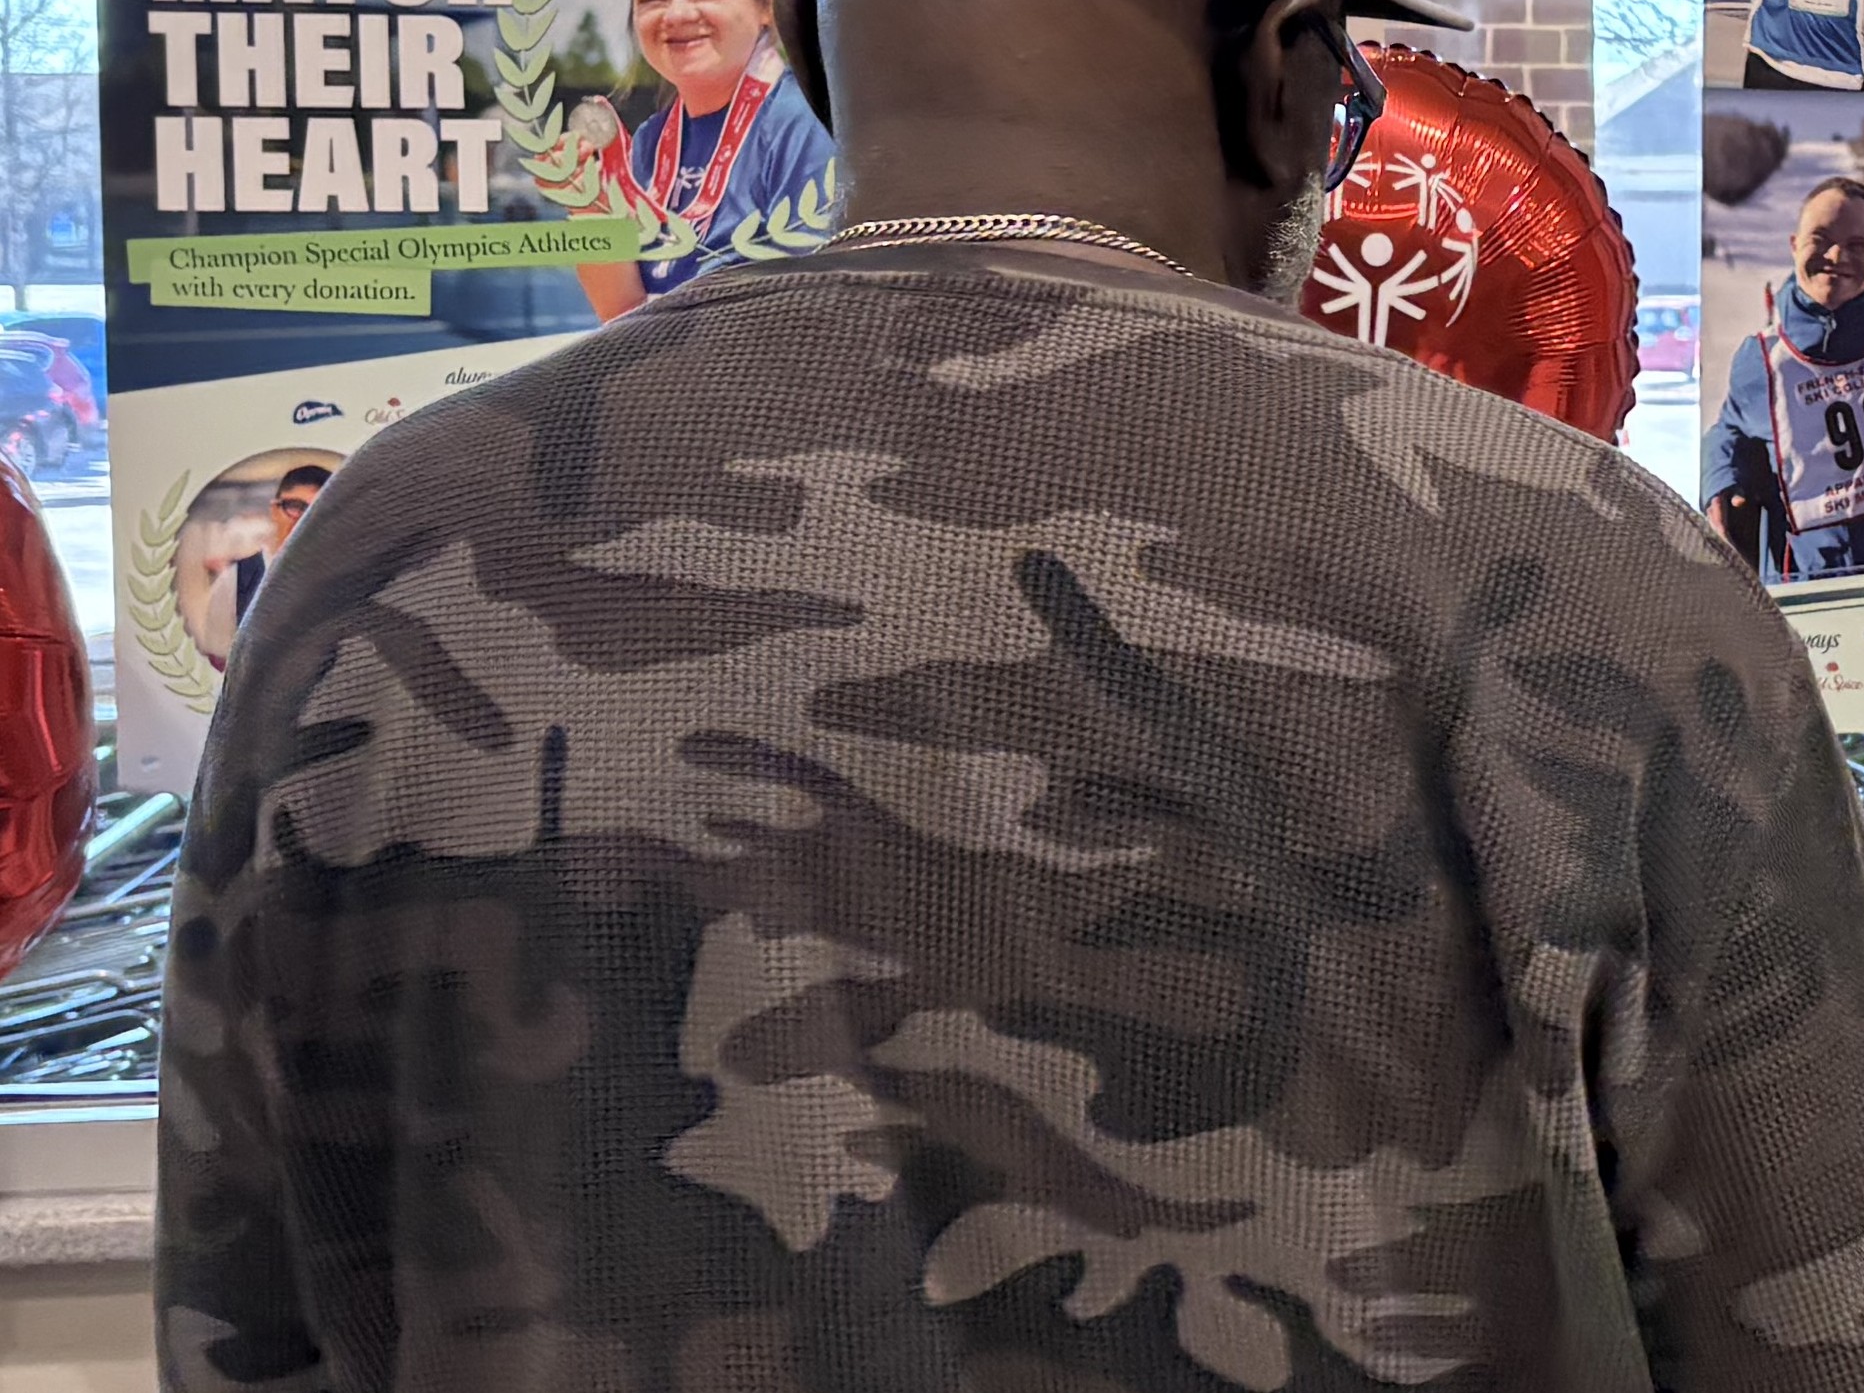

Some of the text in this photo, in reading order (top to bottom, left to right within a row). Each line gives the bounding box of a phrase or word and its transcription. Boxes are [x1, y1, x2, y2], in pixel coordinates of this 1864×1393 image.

[148, 10, 466, 110] THEIR
[153, 117, 503, 213] HEART
[169, 232, 612, 274] Champion Special Olympics Athletes
[172, 278, 416, 305] with every donation.
[1824, 492, 1851, 514] SKI
